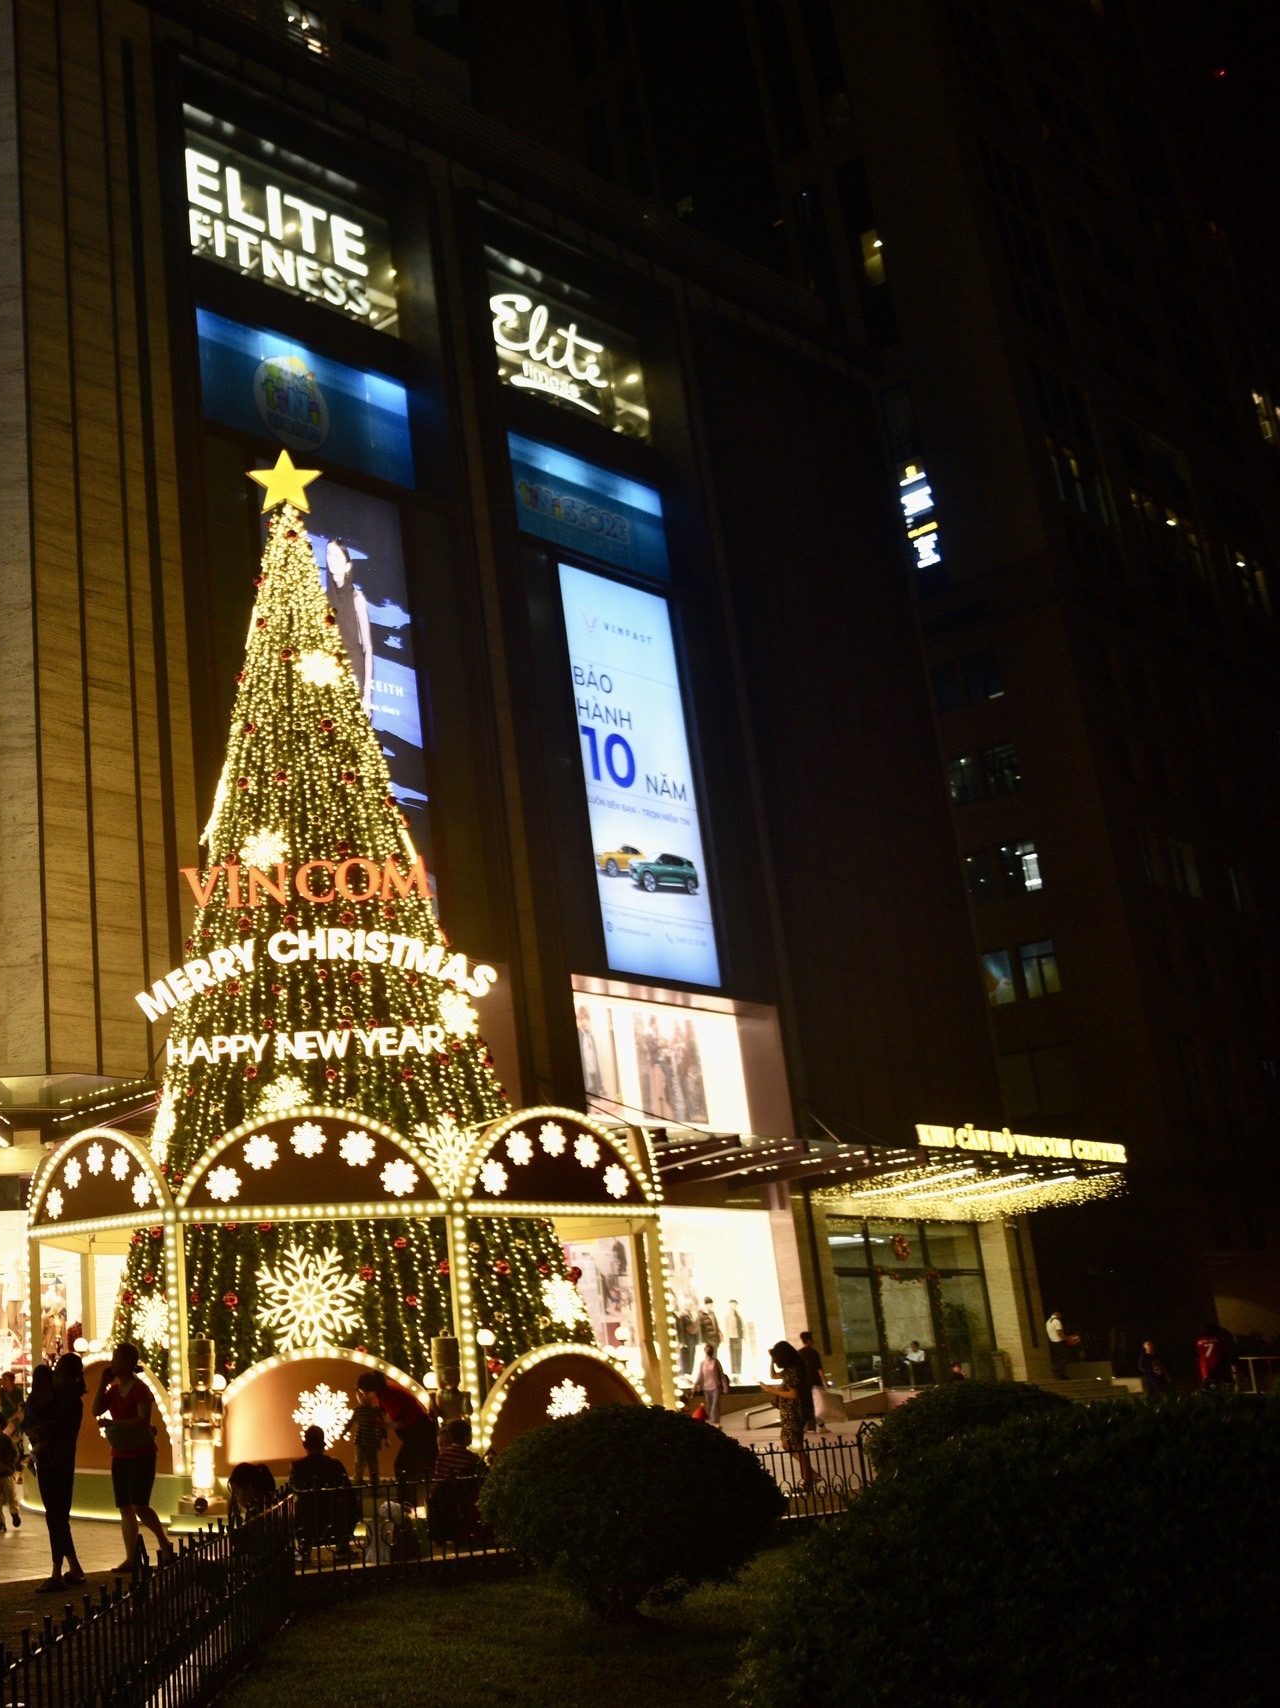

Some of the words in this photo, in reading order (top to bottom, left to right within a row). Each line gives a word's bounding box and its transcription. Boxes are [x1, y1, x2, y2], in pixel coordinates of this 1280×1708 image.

[185, 148, 368, 277] ELITE
[189, 209, 371, 315] FITNESS
[489, 293, 609, 388] Elite
[573, 664, 613, 693] BẢO
[577, 695, 632, 731] HÀNH
[580, 725, 635, 789] 10
[646, 772, 687, 803] NĂM
[180, 854, 434, 908] VINCOM
[135, 938, 255, 1023] MERRY
[267, 927, 498, 998] CHRISTMAS
[166, 1033, 269, 1066] HAPPY
[278, 1029, 351, 1062] NEW
[356, 1025, 446, 1057] YEAR
[1072, 1139, 1128, 1163] CENTER
[1204, 1343, 1214, 1357] 7
